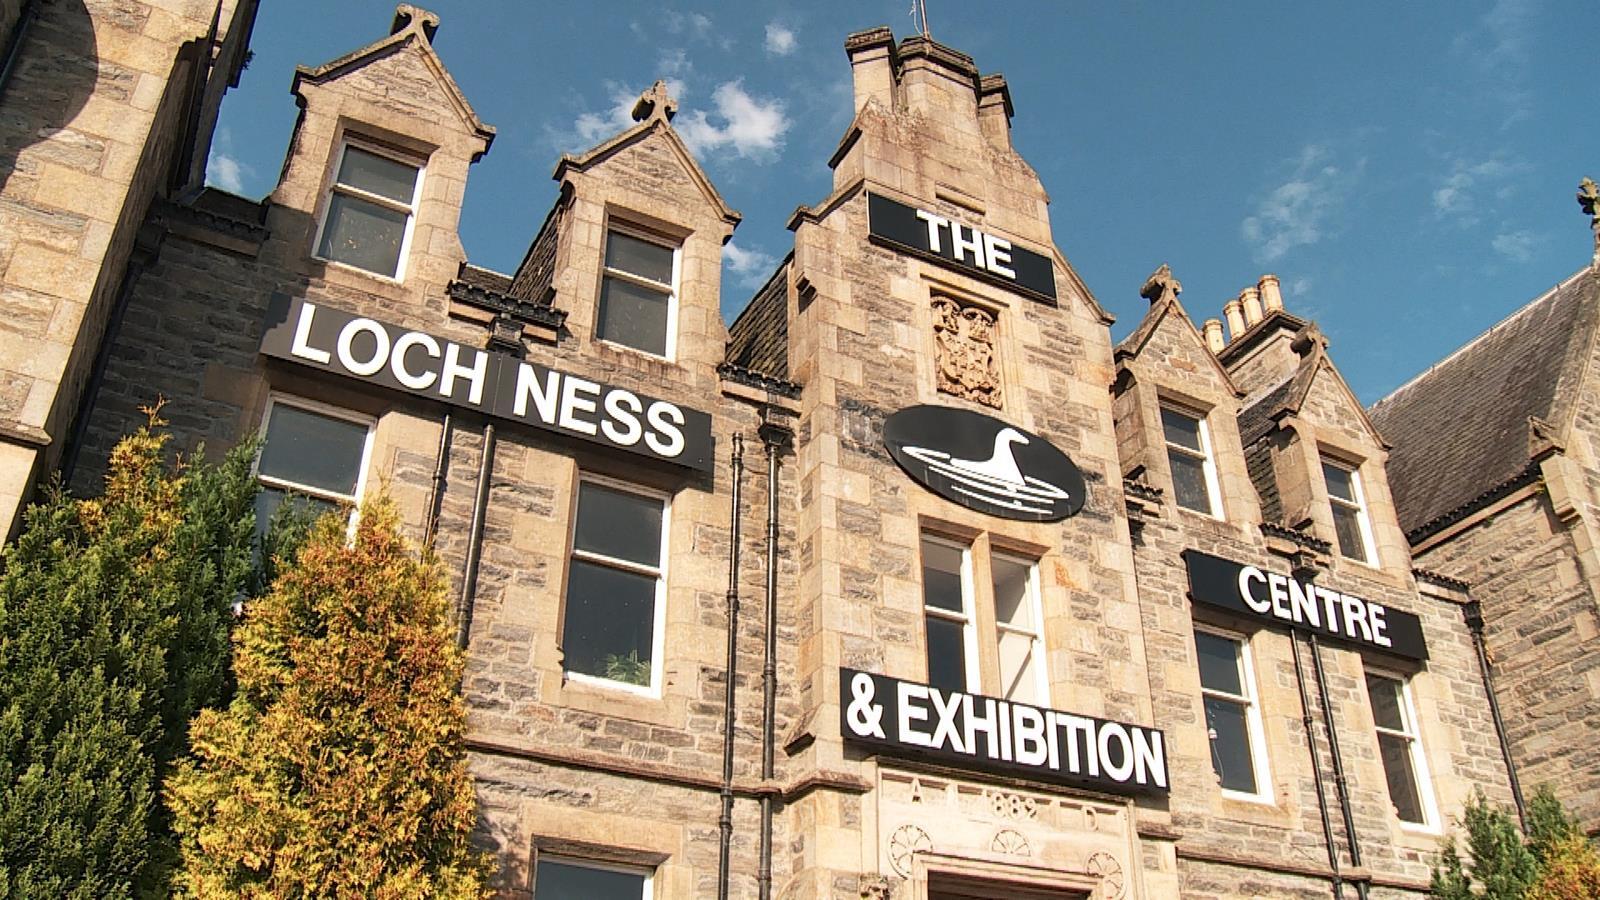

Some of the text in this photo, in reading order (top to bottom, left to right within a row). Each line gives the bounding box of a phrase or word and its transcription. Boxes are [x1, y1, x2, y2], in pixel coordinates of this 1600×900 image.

[916, 208, 1016, 280] THE
[290, 301, 687, 458] LOCH NESS
[1238, 566, 1392, 648] CENTRE
[846, 672, 1167, 787] & EXHIBITION
